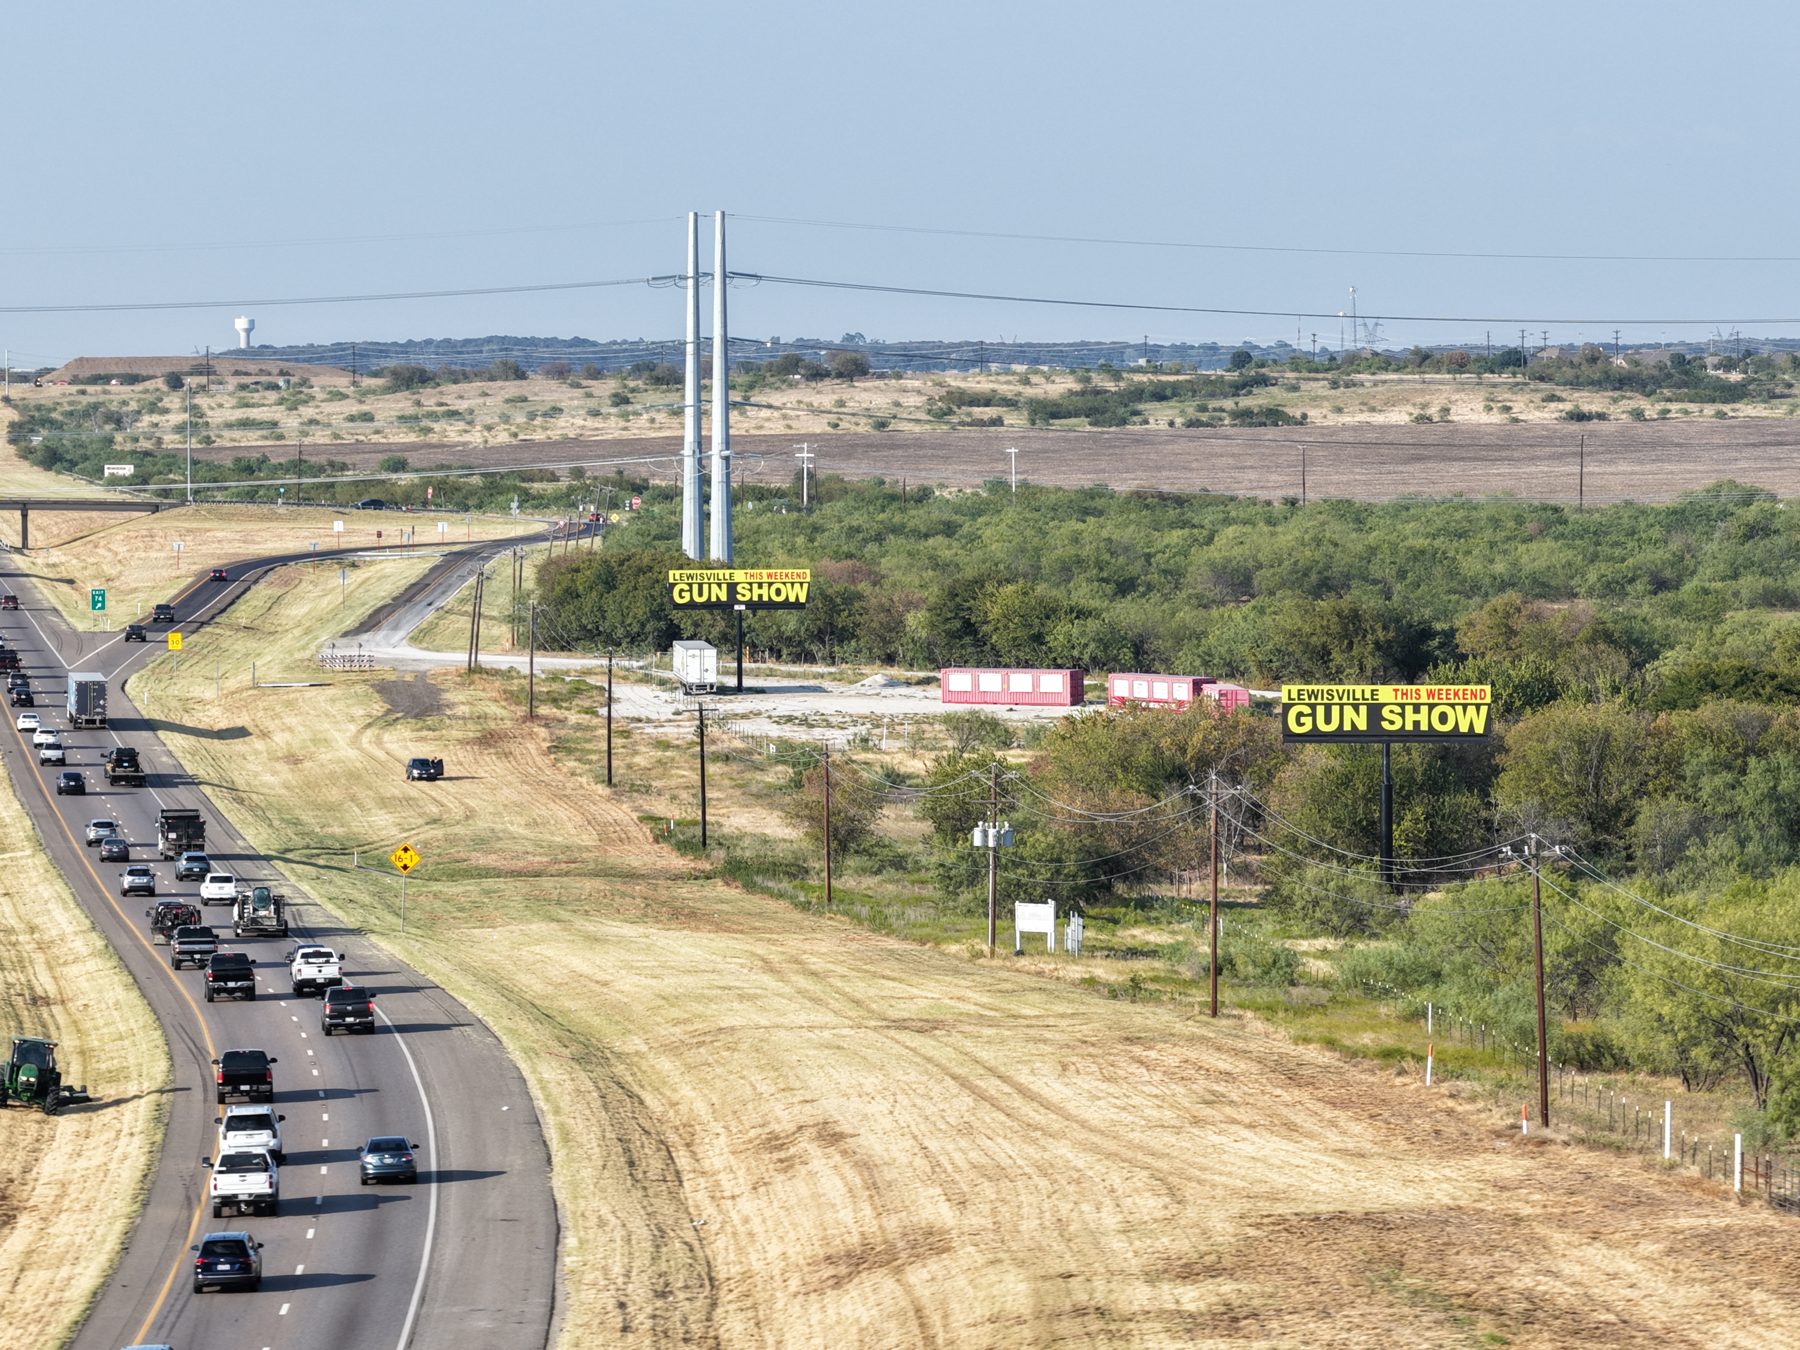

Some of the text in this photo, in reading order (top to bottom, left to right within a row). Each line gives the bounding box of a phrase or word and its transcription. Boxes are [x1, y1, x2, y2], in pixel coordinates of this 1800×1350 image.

[672, 571, 808, 582] LEWISVILLE THIS WEEKEND
[672, 582, 809, 604] GUN SHOW
[1287, 688, 1487, 702] LEWISVILLE THIS WEEKEND
[1287, 704, 1489, 734] GUN SHOW
